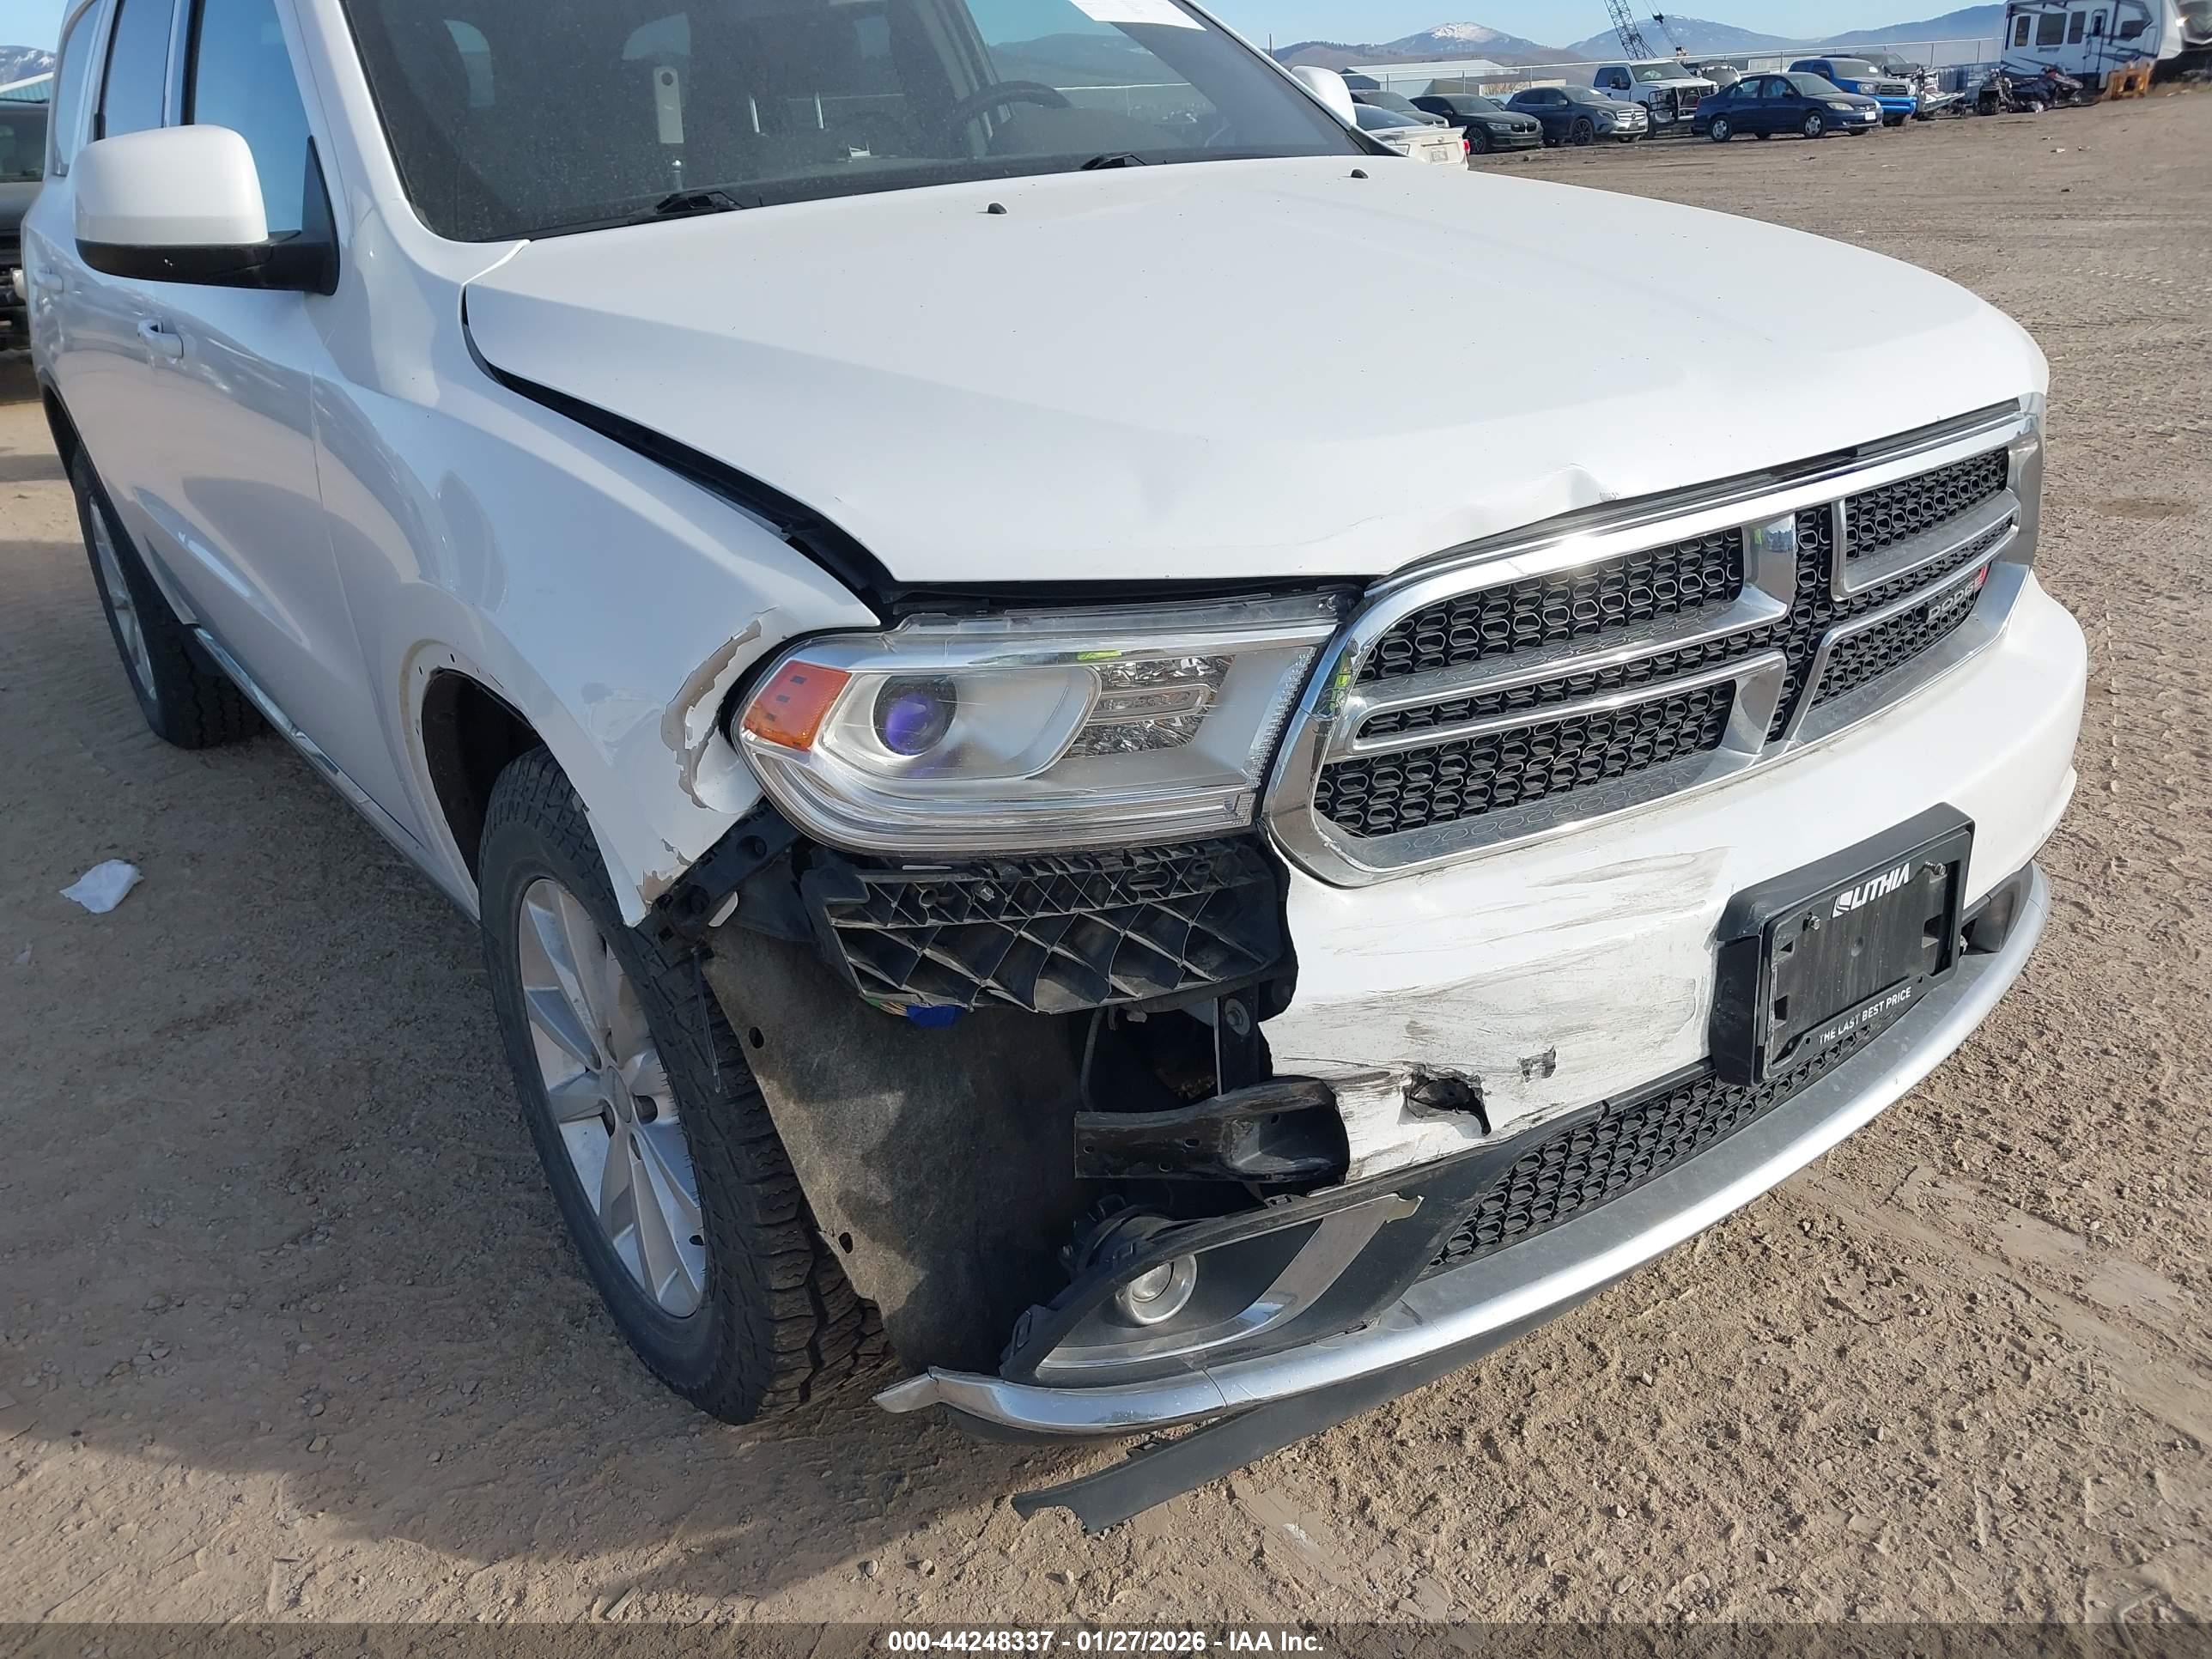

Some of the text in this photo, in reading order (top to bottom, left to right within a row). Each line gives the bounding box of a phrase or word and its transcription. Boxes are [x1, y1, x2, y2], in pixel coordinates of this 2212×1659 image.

[1850, 862, 1910, 910] LITHIA
[1818, 986, 1911, 1046] THE LAST BEST PRICE
